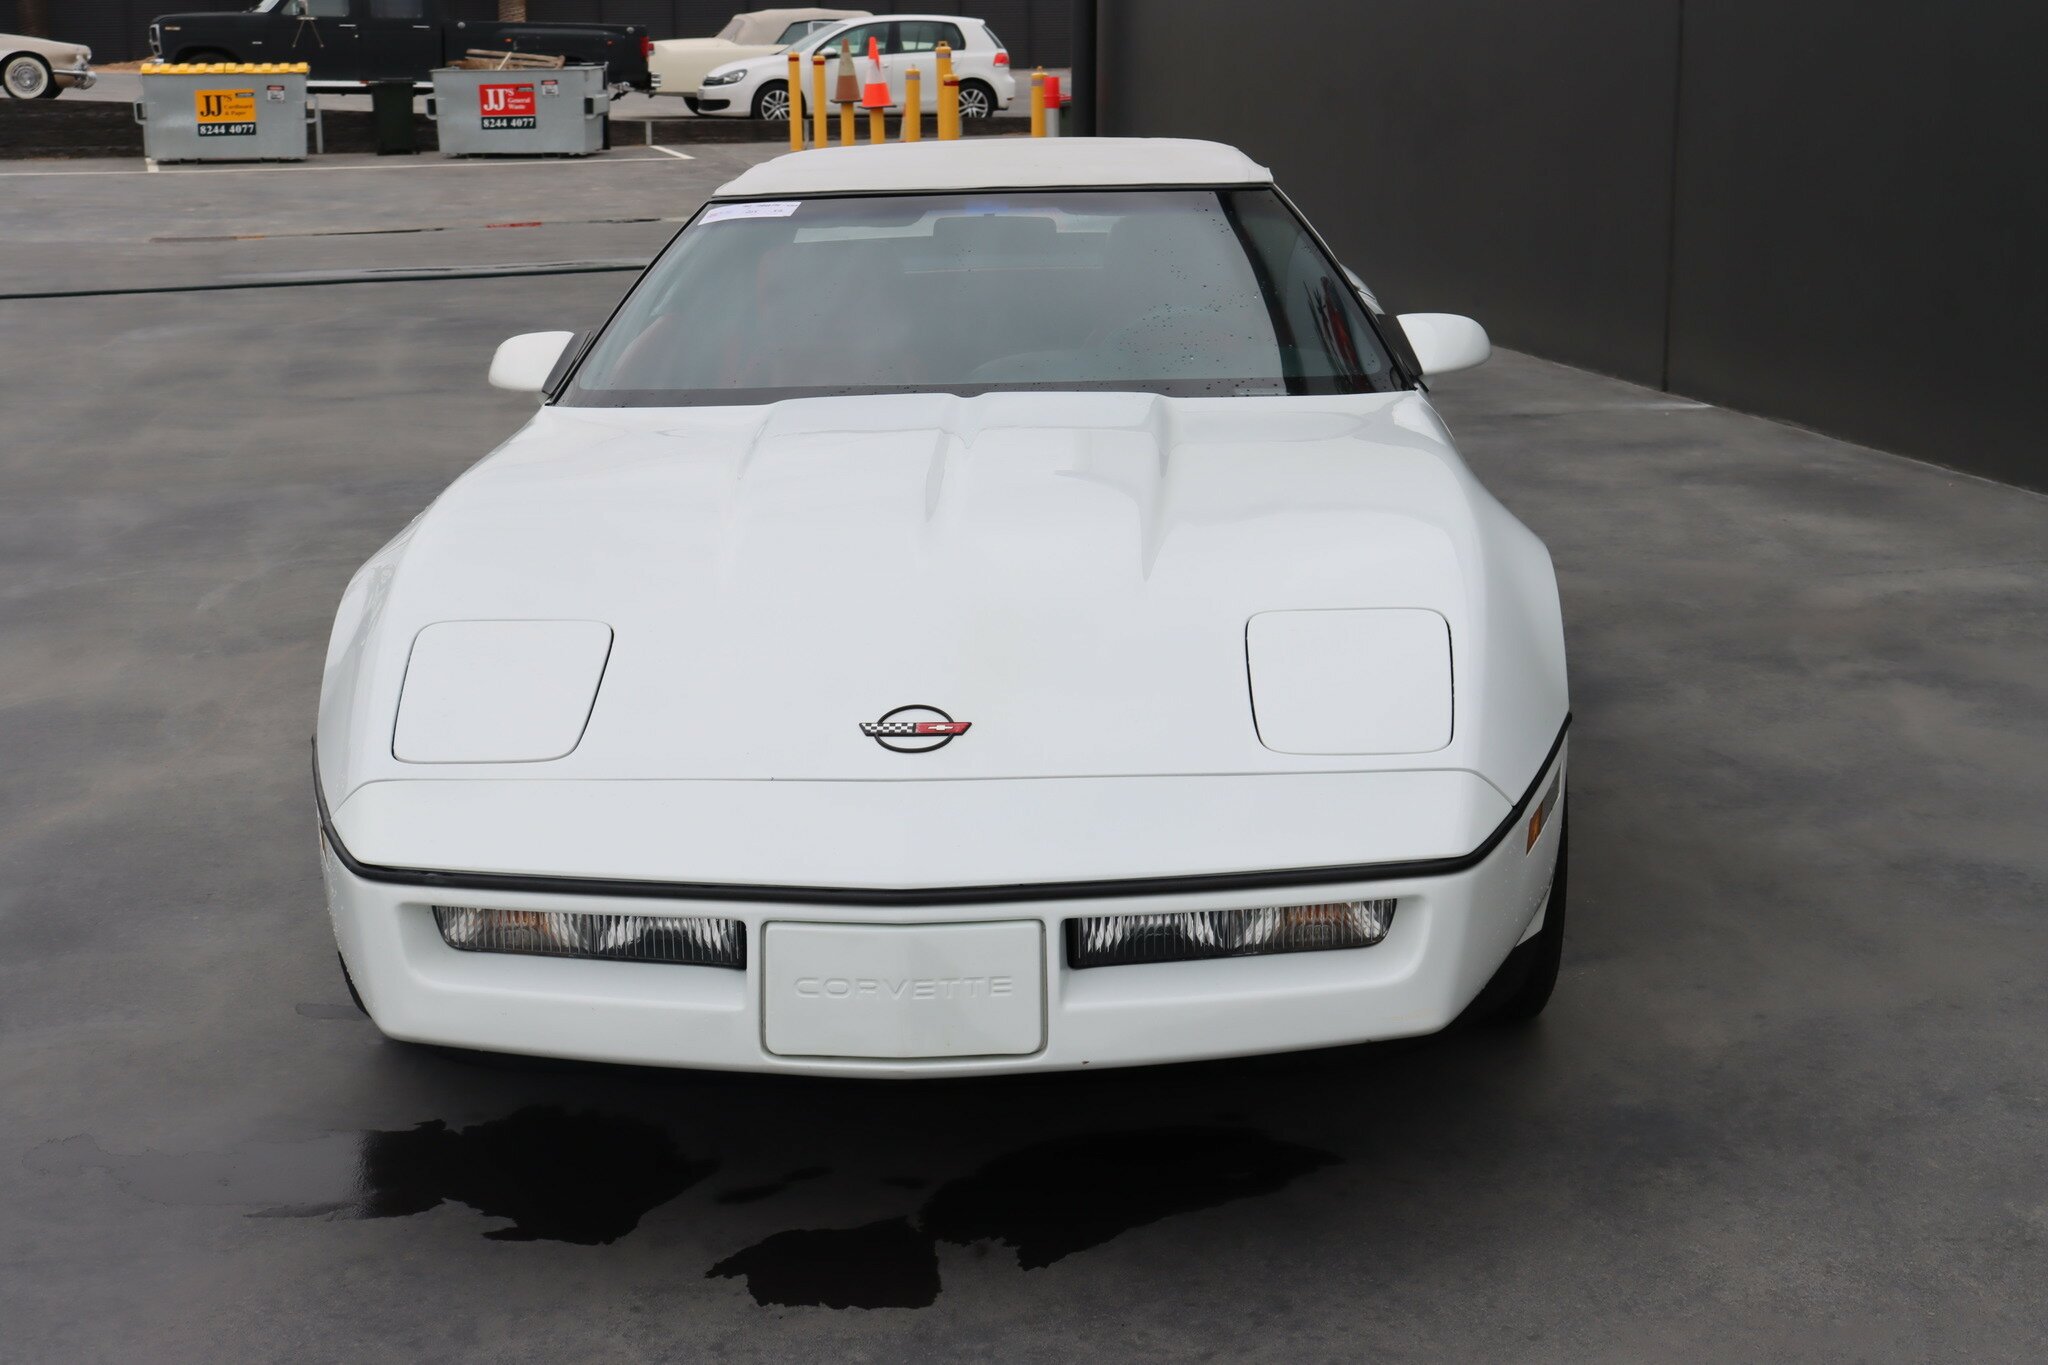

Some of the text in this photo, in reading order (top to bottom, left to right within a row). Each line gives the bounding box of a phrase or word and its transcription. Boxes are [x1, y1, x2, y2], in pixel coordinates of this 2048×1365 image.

[483, 118, 534, 128] 8244 4077
[200, 124, 254, 135] 8244 4077
[794, 975, 1013, 1000] CORVETTE
